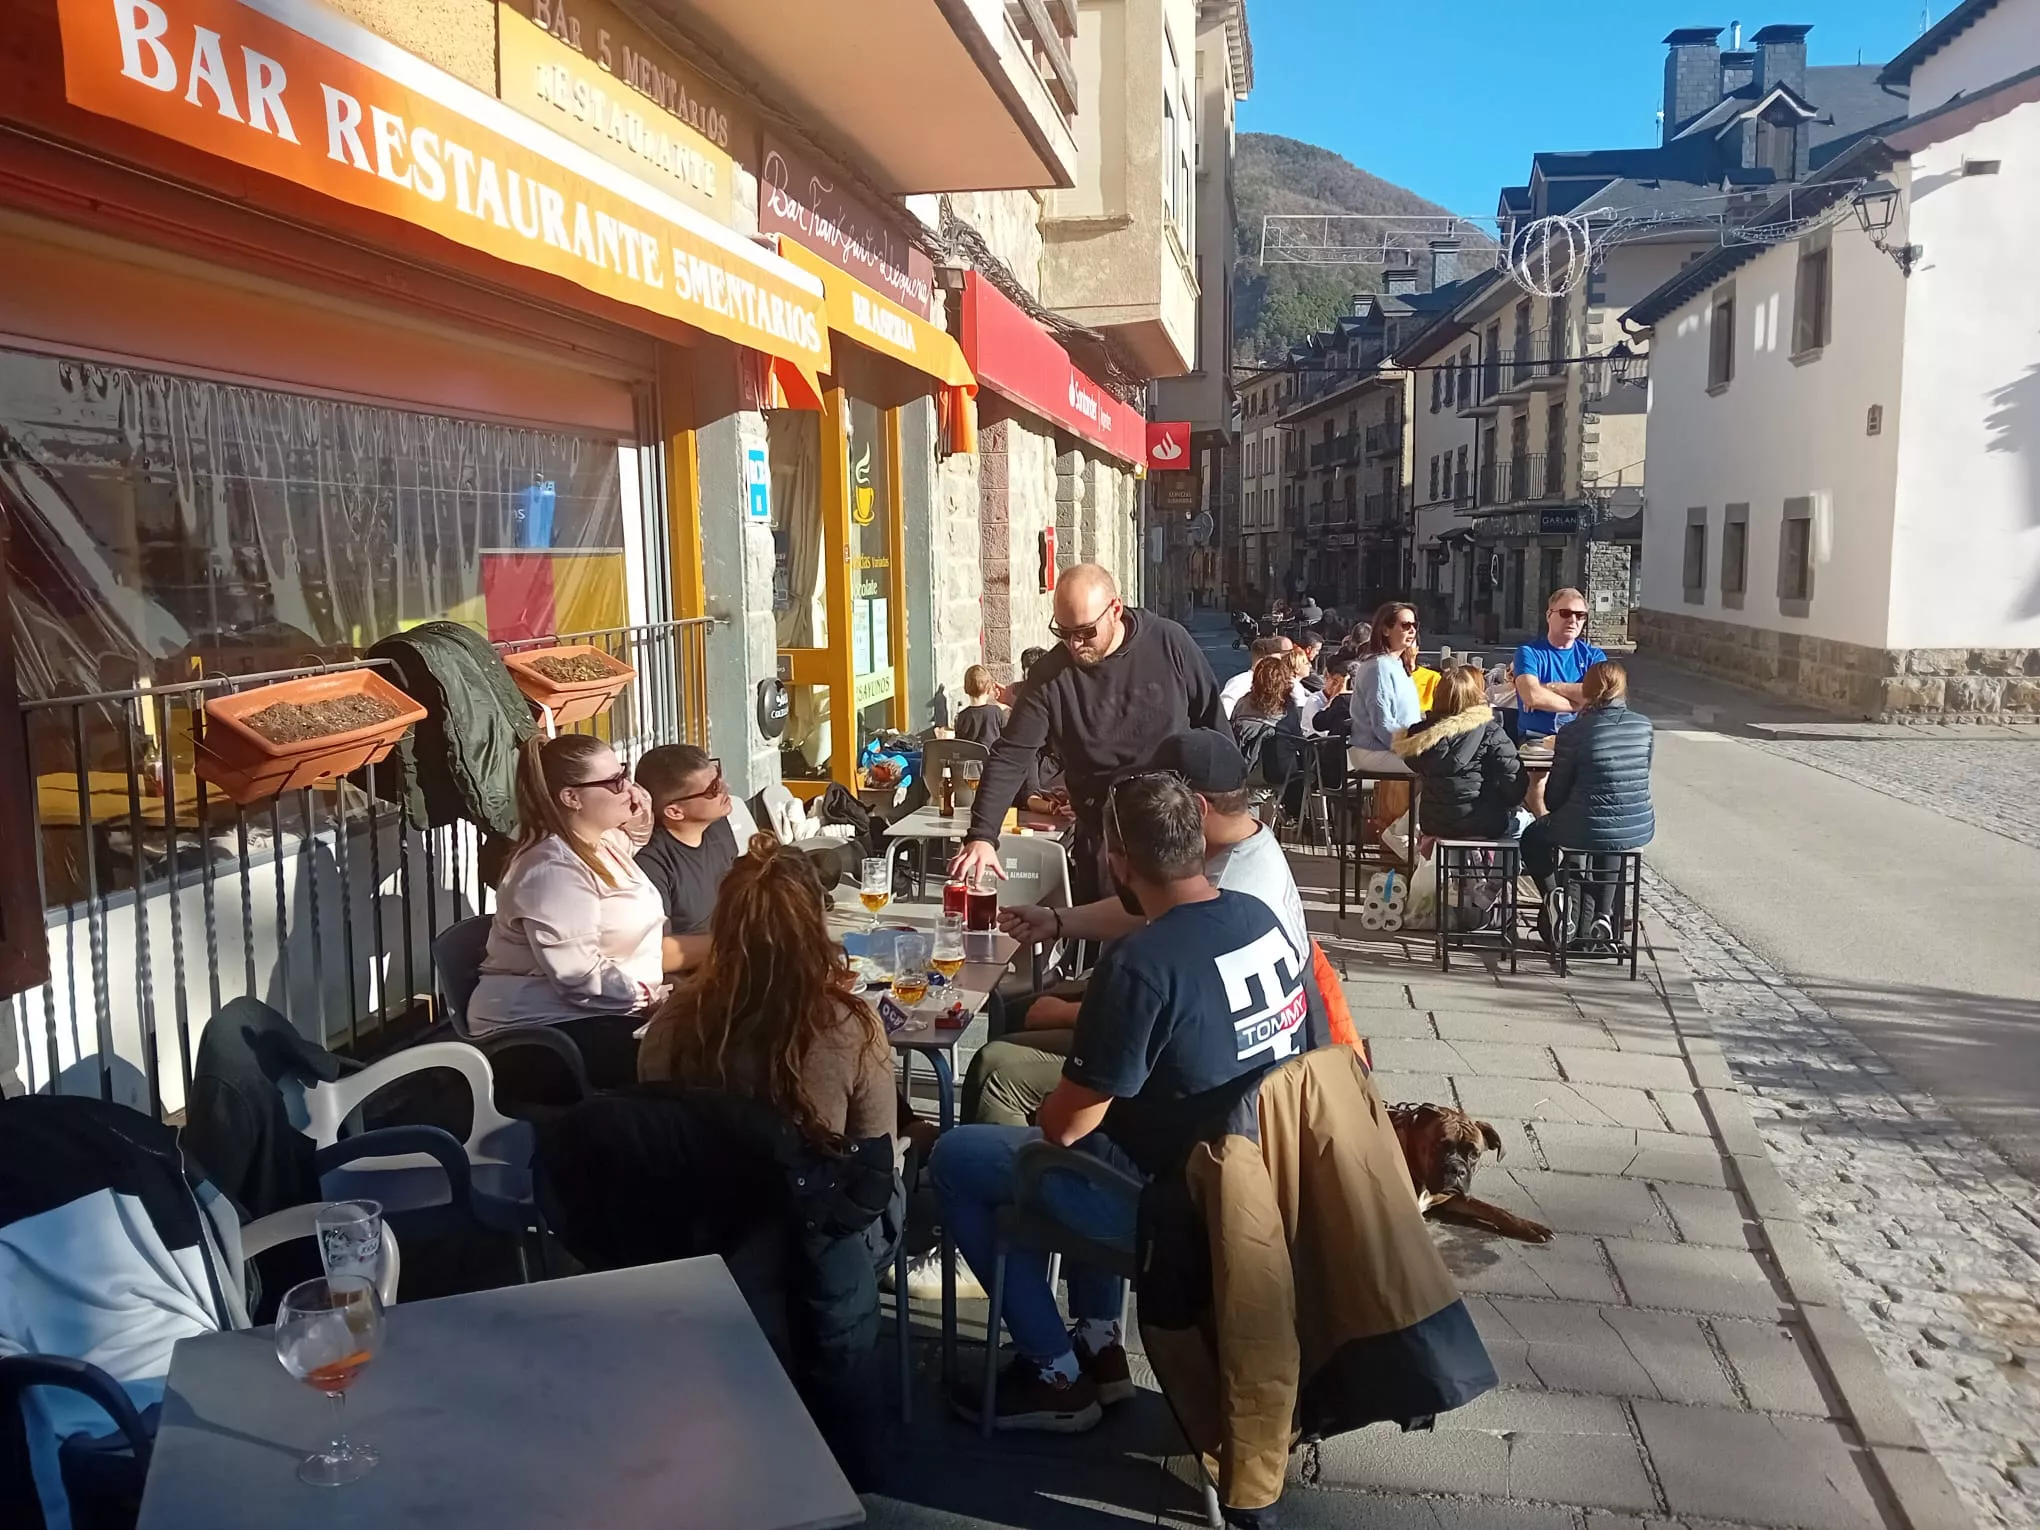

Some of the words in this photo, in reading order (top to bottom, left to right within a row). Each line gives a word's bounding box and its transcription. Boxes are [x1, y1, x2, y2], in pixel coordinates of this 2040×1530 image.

[597, 29, 613, 72] 5
[622, 45, 729, 148] MENTARIOS
[114, 0, 301, 146] BAR
[319, 81, 665, 289] RESTAURANTE
[671, 247, 823, 354] 5MENTARIOS
[764, 150, 808, 231] Bar
[1242, 993, 1305, 1046] TOMMY
